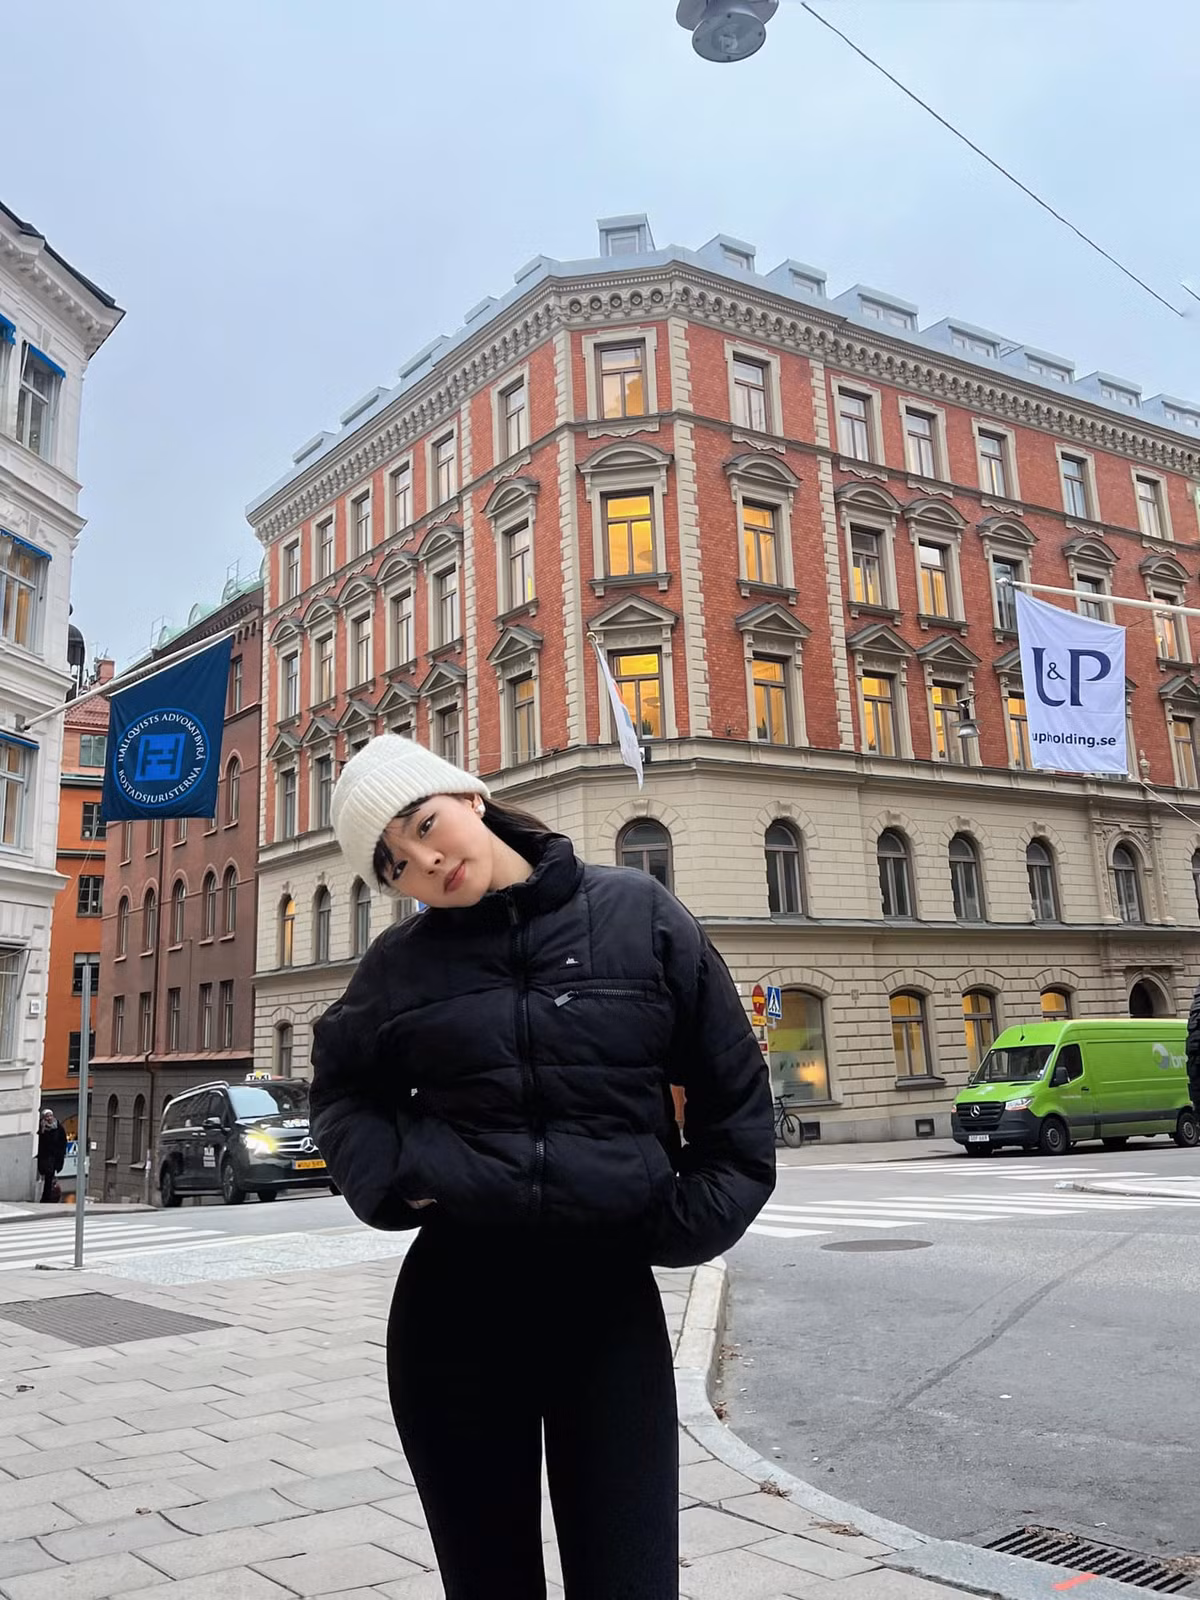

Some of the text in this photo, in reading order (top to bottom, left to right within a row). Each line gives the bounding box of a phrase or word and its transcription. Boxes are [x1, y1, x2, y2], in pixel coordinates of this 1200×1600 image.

[118, 714, 159, 762] HALLQVISTS
[1032, 732, 1116, 748] upholding.se
[118, 767, 201, 803] BOSTADSJURISTERNA
